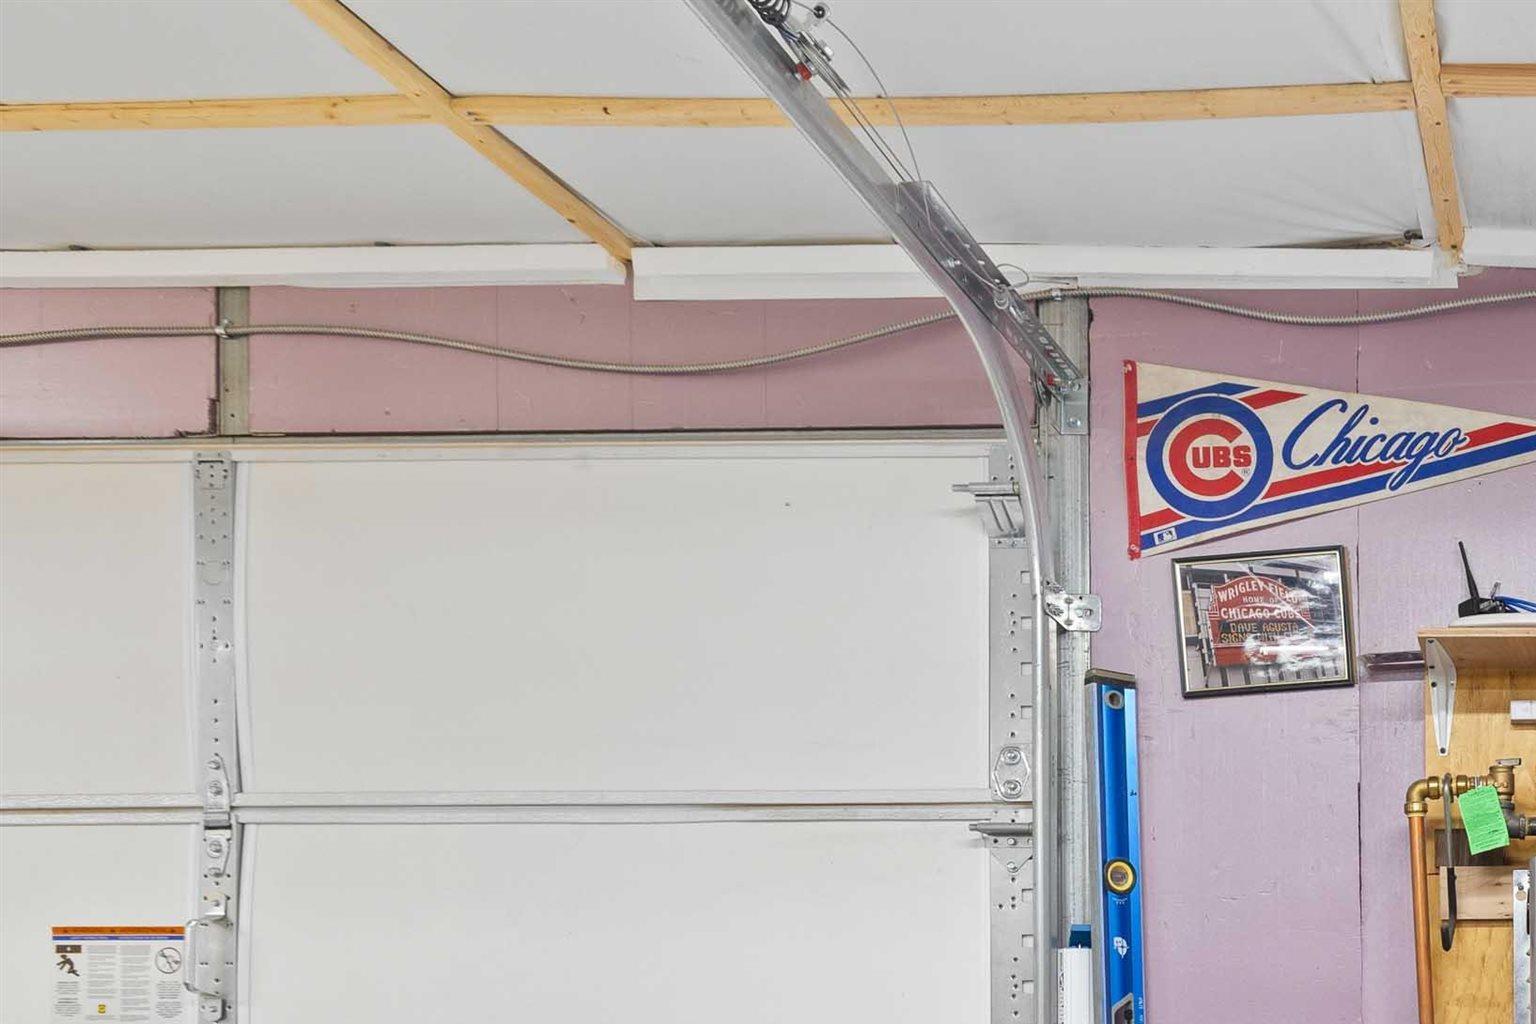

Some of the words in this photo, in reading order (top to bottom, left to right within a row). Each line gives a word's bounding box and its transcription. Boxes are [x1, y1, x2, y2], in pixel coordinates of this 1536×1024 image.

[1281, 399, 1467, 492] Chicago
[1168, 418, 1253, 497] CUBS
[1217, 580, 1265, 603] WRIGLEY
[1220, 606, 1271, 620] CHICAGO
[1230, 622, 1259, 634] DAVE
